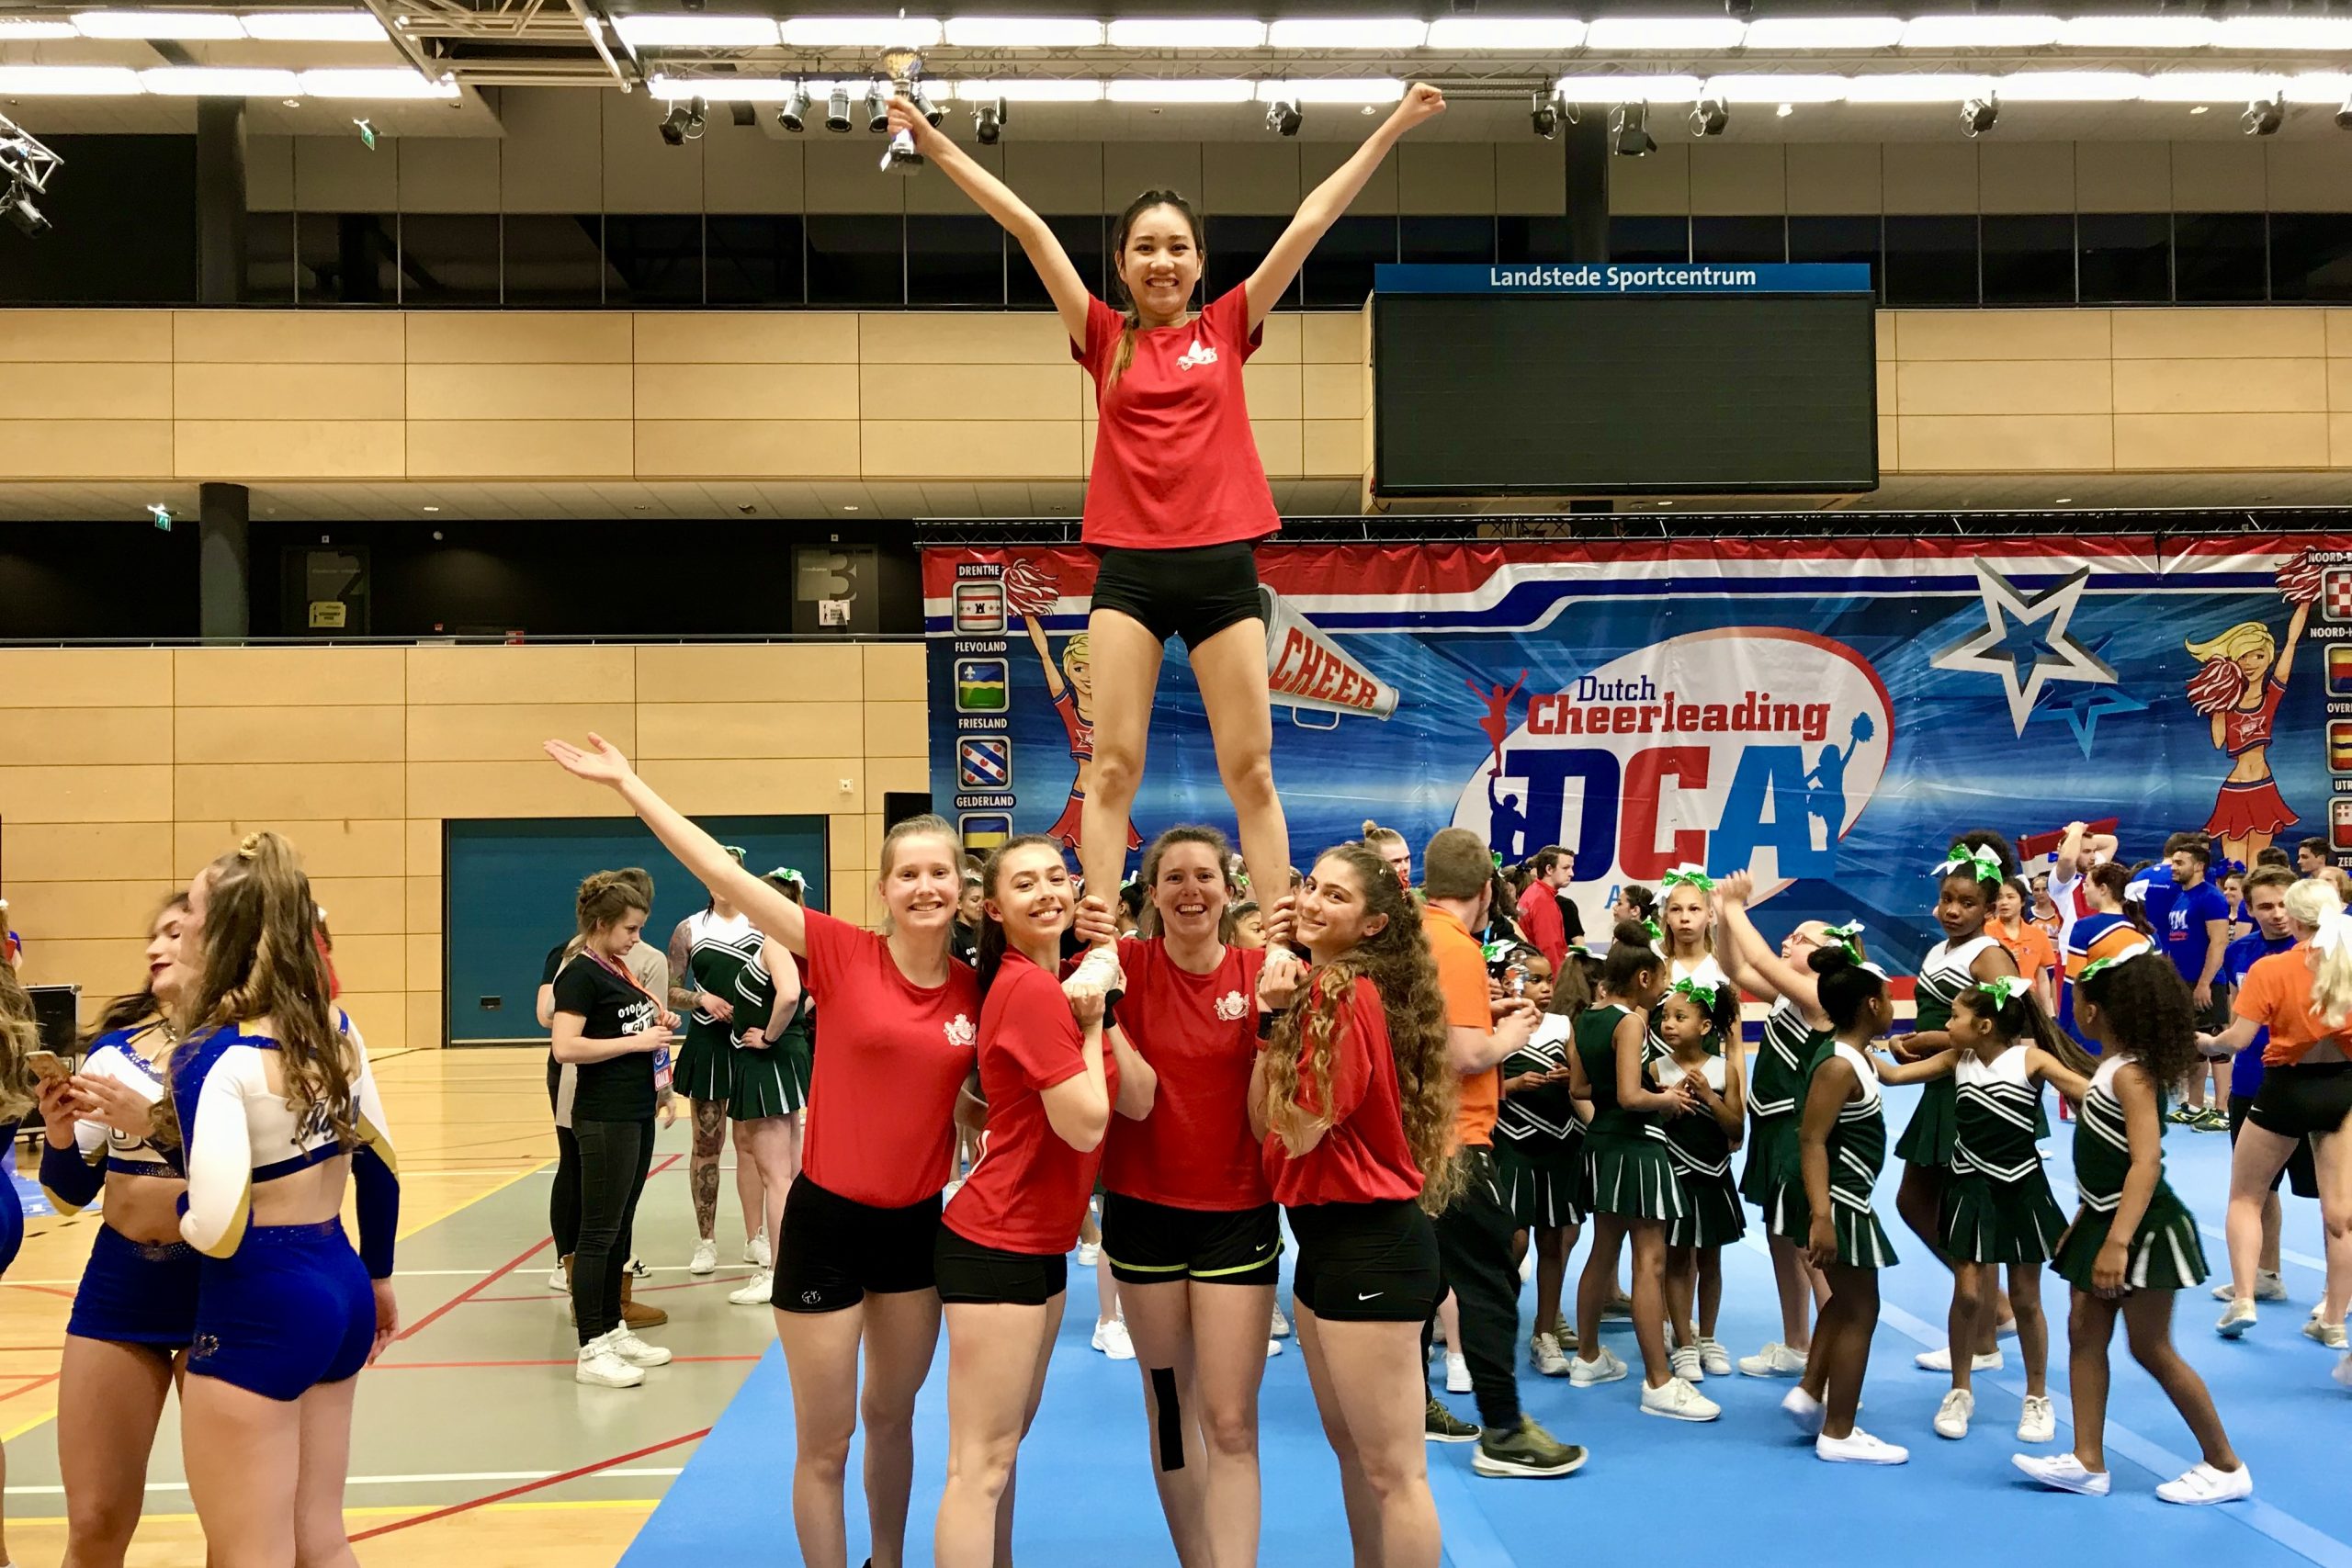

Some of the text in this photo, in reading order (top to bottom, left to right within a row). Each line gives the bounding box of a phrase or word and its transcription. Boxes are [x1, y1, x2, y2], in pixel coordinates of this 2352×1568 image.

[1490, 266, 1757, 290] Landstede Sportcentrum
[829, 549, 857, 600] 3
[958, 565, 1001, 576] DRENTHE
[955, 641, 1007, 652] FLEVOLAND
[1270, 626, 1378, 710] CHEER
[1577, 675, 1656, 703] Dutch
[958, 717, 1008, 729] FRIESLAND
[1527, 691, 1830, 741] Cheerleading
[956, 795, 1014, 807] GELDERLAND
[1492, 745, 1837, 882] DCA
